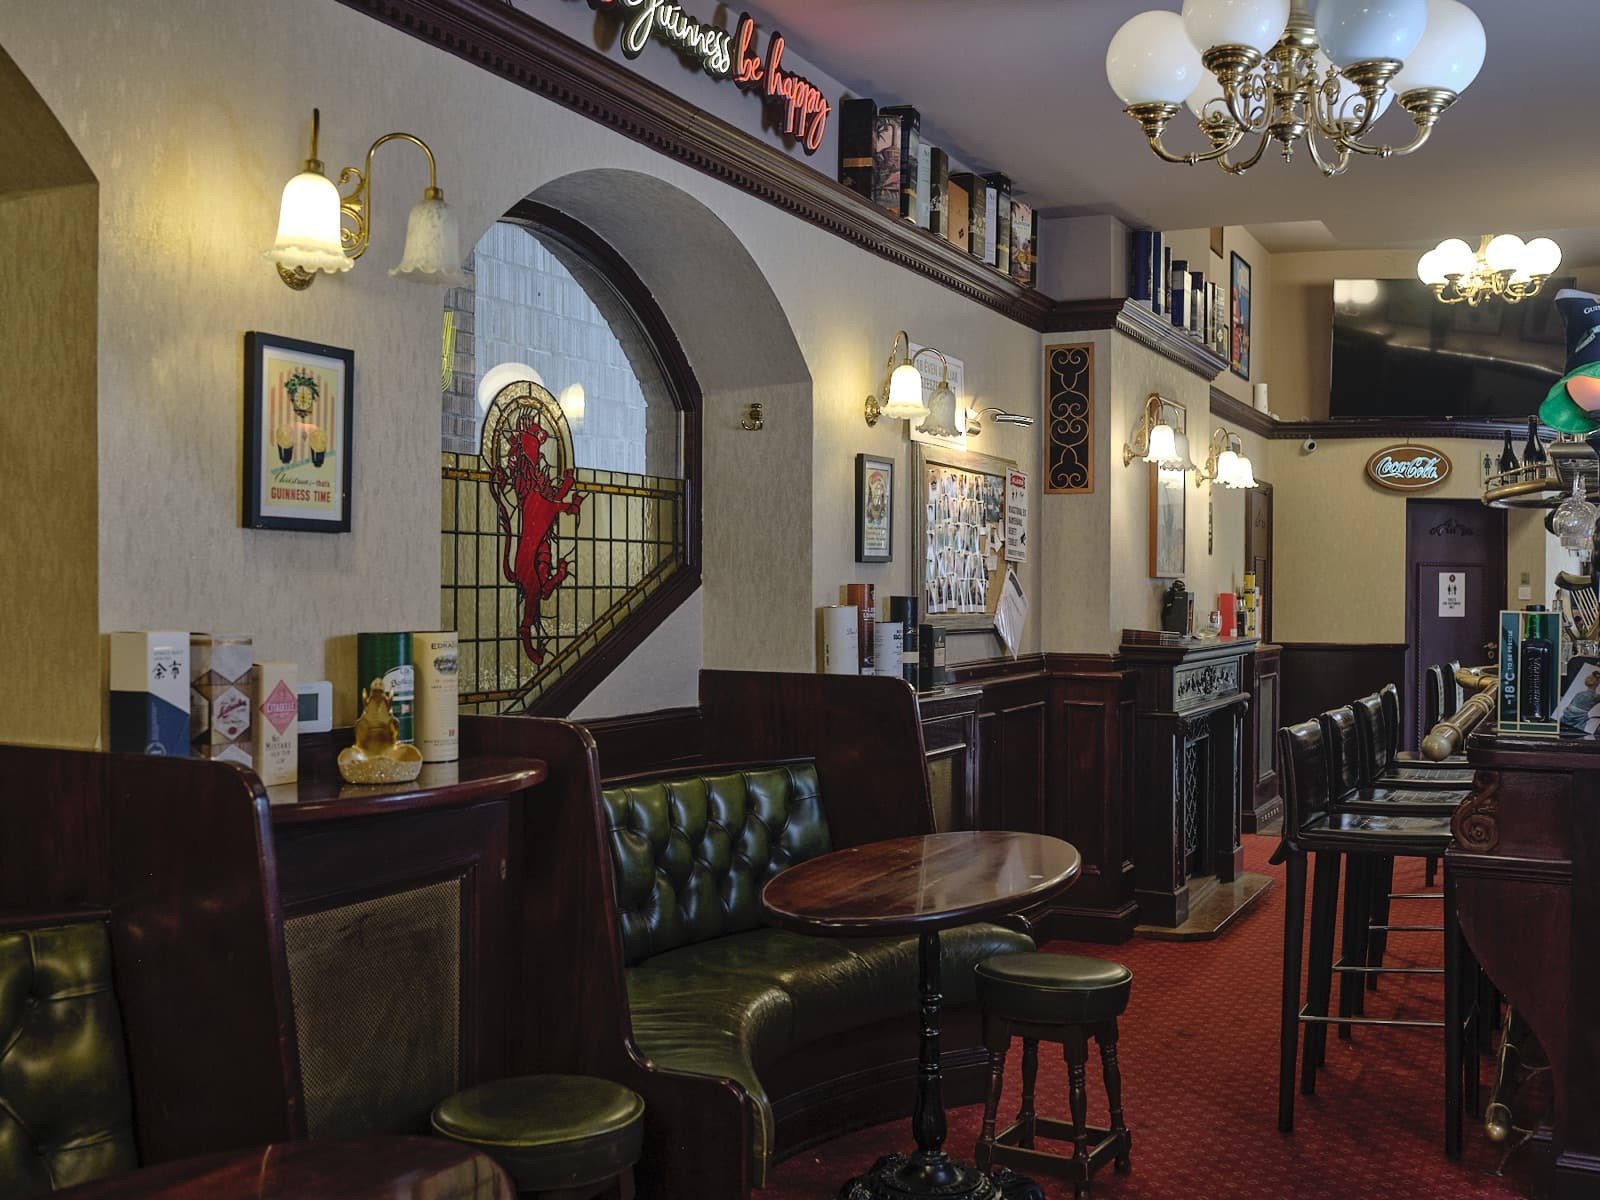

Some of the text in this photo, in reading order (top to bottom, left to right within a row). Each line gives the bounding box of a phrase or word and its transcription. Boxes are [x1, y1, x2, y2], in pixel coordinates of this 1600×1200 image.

[735, 18, 763, 82] be
[767, 36, 831, 150] happy
[1376, 456, 1441, 478] Coca-Cola
[271, 486, 331, 503] GUINNESS TIME
[1504, 672, 1516, 705] -18°C
